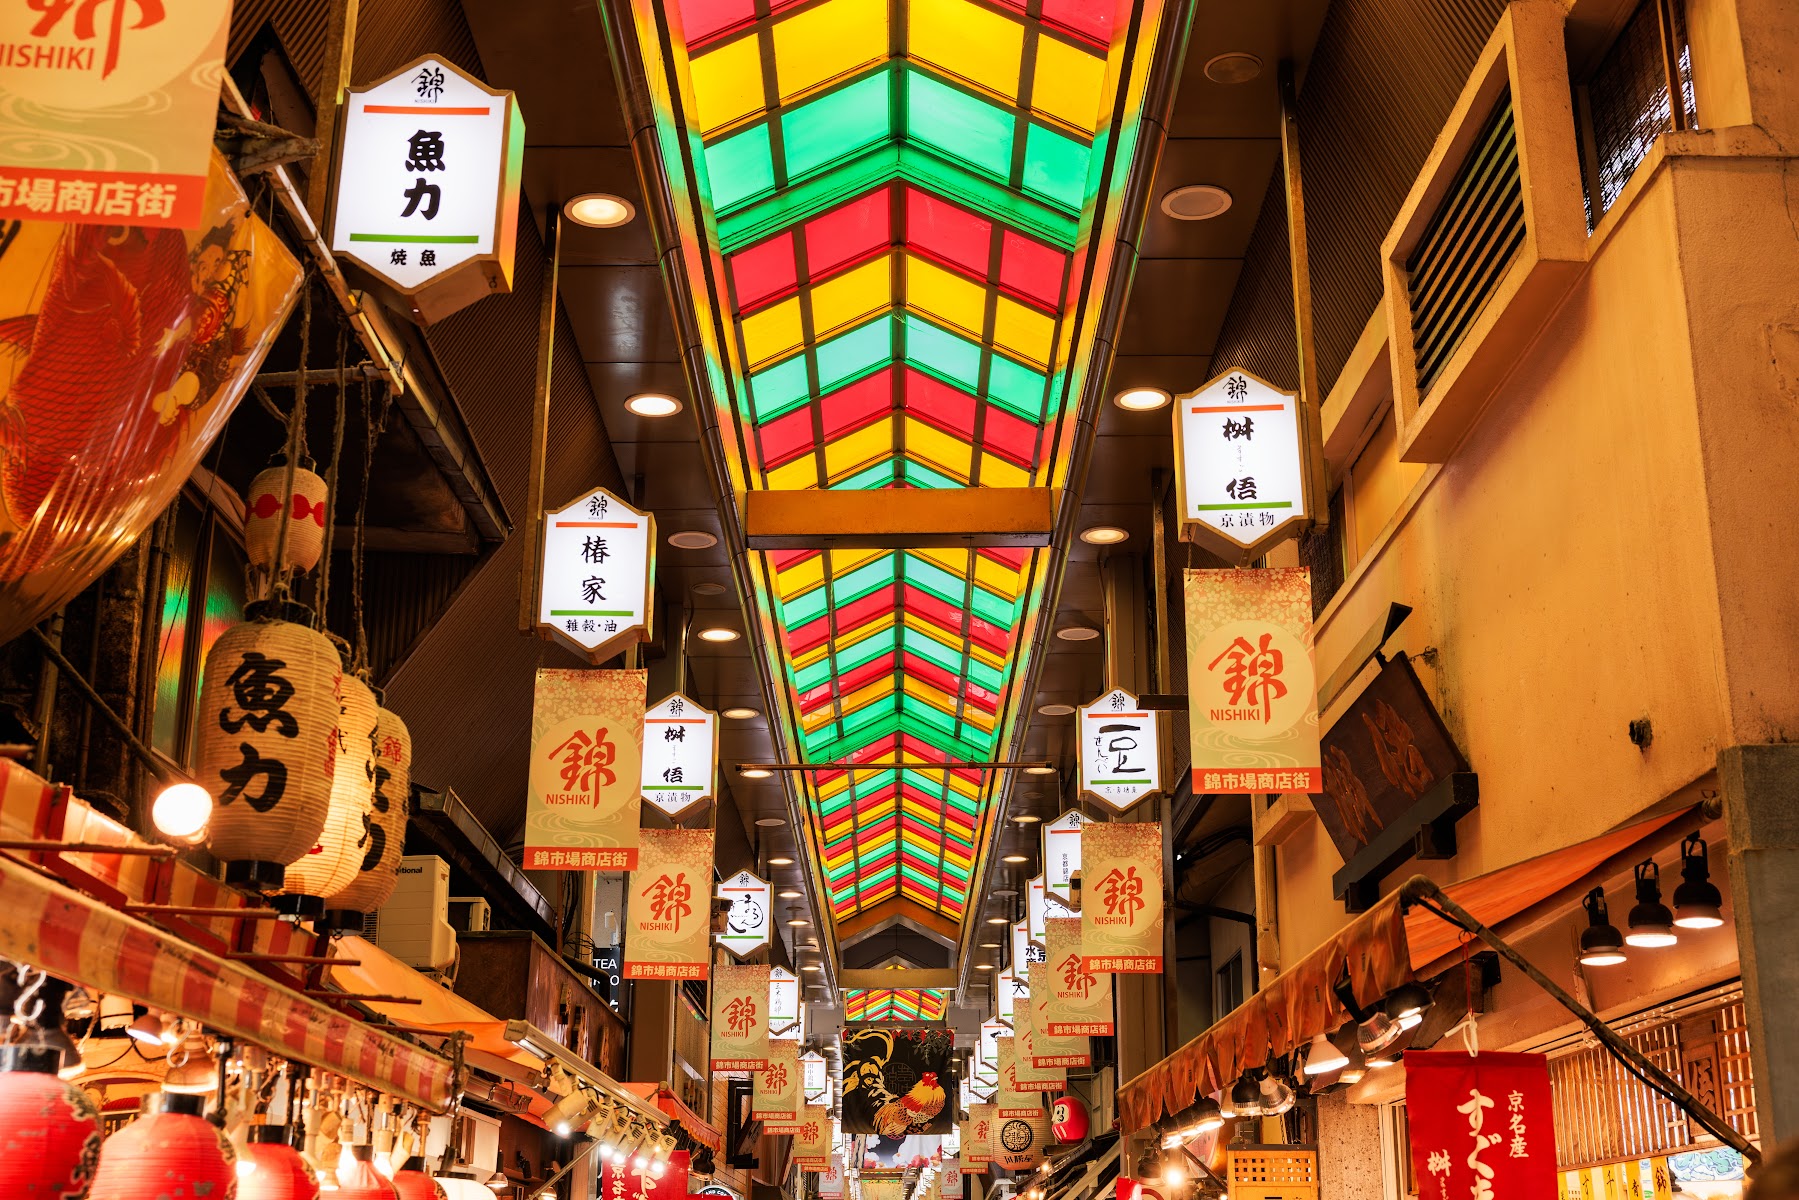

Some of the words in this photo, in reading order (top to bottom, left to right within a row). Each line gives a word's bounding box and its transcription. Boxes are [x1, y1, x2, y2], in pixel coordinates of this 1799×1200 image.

[0, 43, 95, 71] ISHIKI
[400, 129, 446, 221] 魚力
[390, 249, 436, 266] 焼魚
[1219, 512, 1275, 527] 京漬物
[581, 535, 611, 604] 椿家
[1207, 633, 1288, 725] 錦
[1210, 708, 1260, 721] NISHIKI
[219, 652, 299, 813] 魚力
[548, 727, 617, 809] 錦
[1204, 772, 1310, 790] 錦市場商店街
[545, 793, 590, 805] NISHIKI
[655, 792, 691, 802] 京漬物
[533, 850, 628, 867] 錦市場商店街
[641, 872, 692, 934] 錦
[1094, 866, 1145, 927] 錦
[640, 922, 672, 931] NISHIKI
[1094, 917, 1127, 925] NISHIKI
[593, 959, 617, 969] TEA
[631, 964, 700, 977] 錦市場商店街
[1089, 959, 1156, 970] 錦市場商店街
[1057, 991, 1083, 999] NISHIKI
[721, 995, 757, 1039] 錦
[1053, 1024, 1108, 1035] 錦市場商店街
[1037, 1056, 1085, 1066] 錦市場商店街
[1507, 1089, 1530, 1159] 京名産
